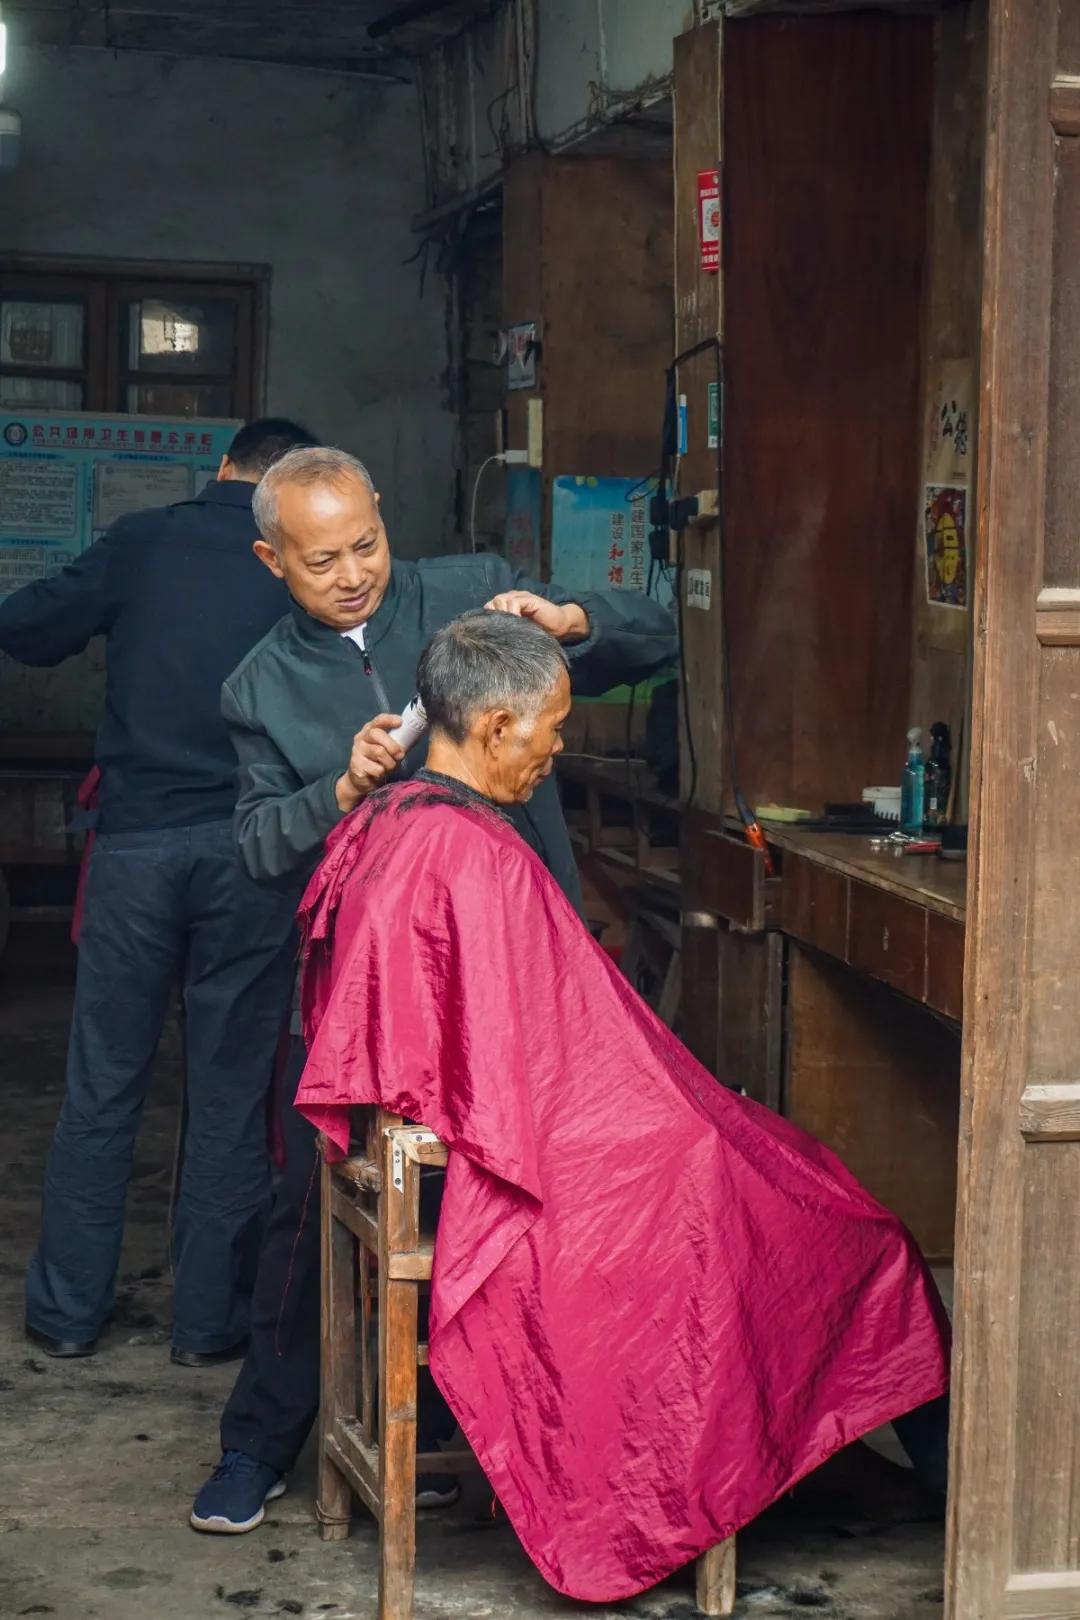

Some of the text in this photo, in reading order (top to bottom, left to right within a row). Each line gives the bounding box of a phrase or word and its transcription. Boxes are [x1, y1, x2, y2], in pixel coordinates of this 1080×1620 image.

[631, 494, 646, 591] 创建国家卫生
